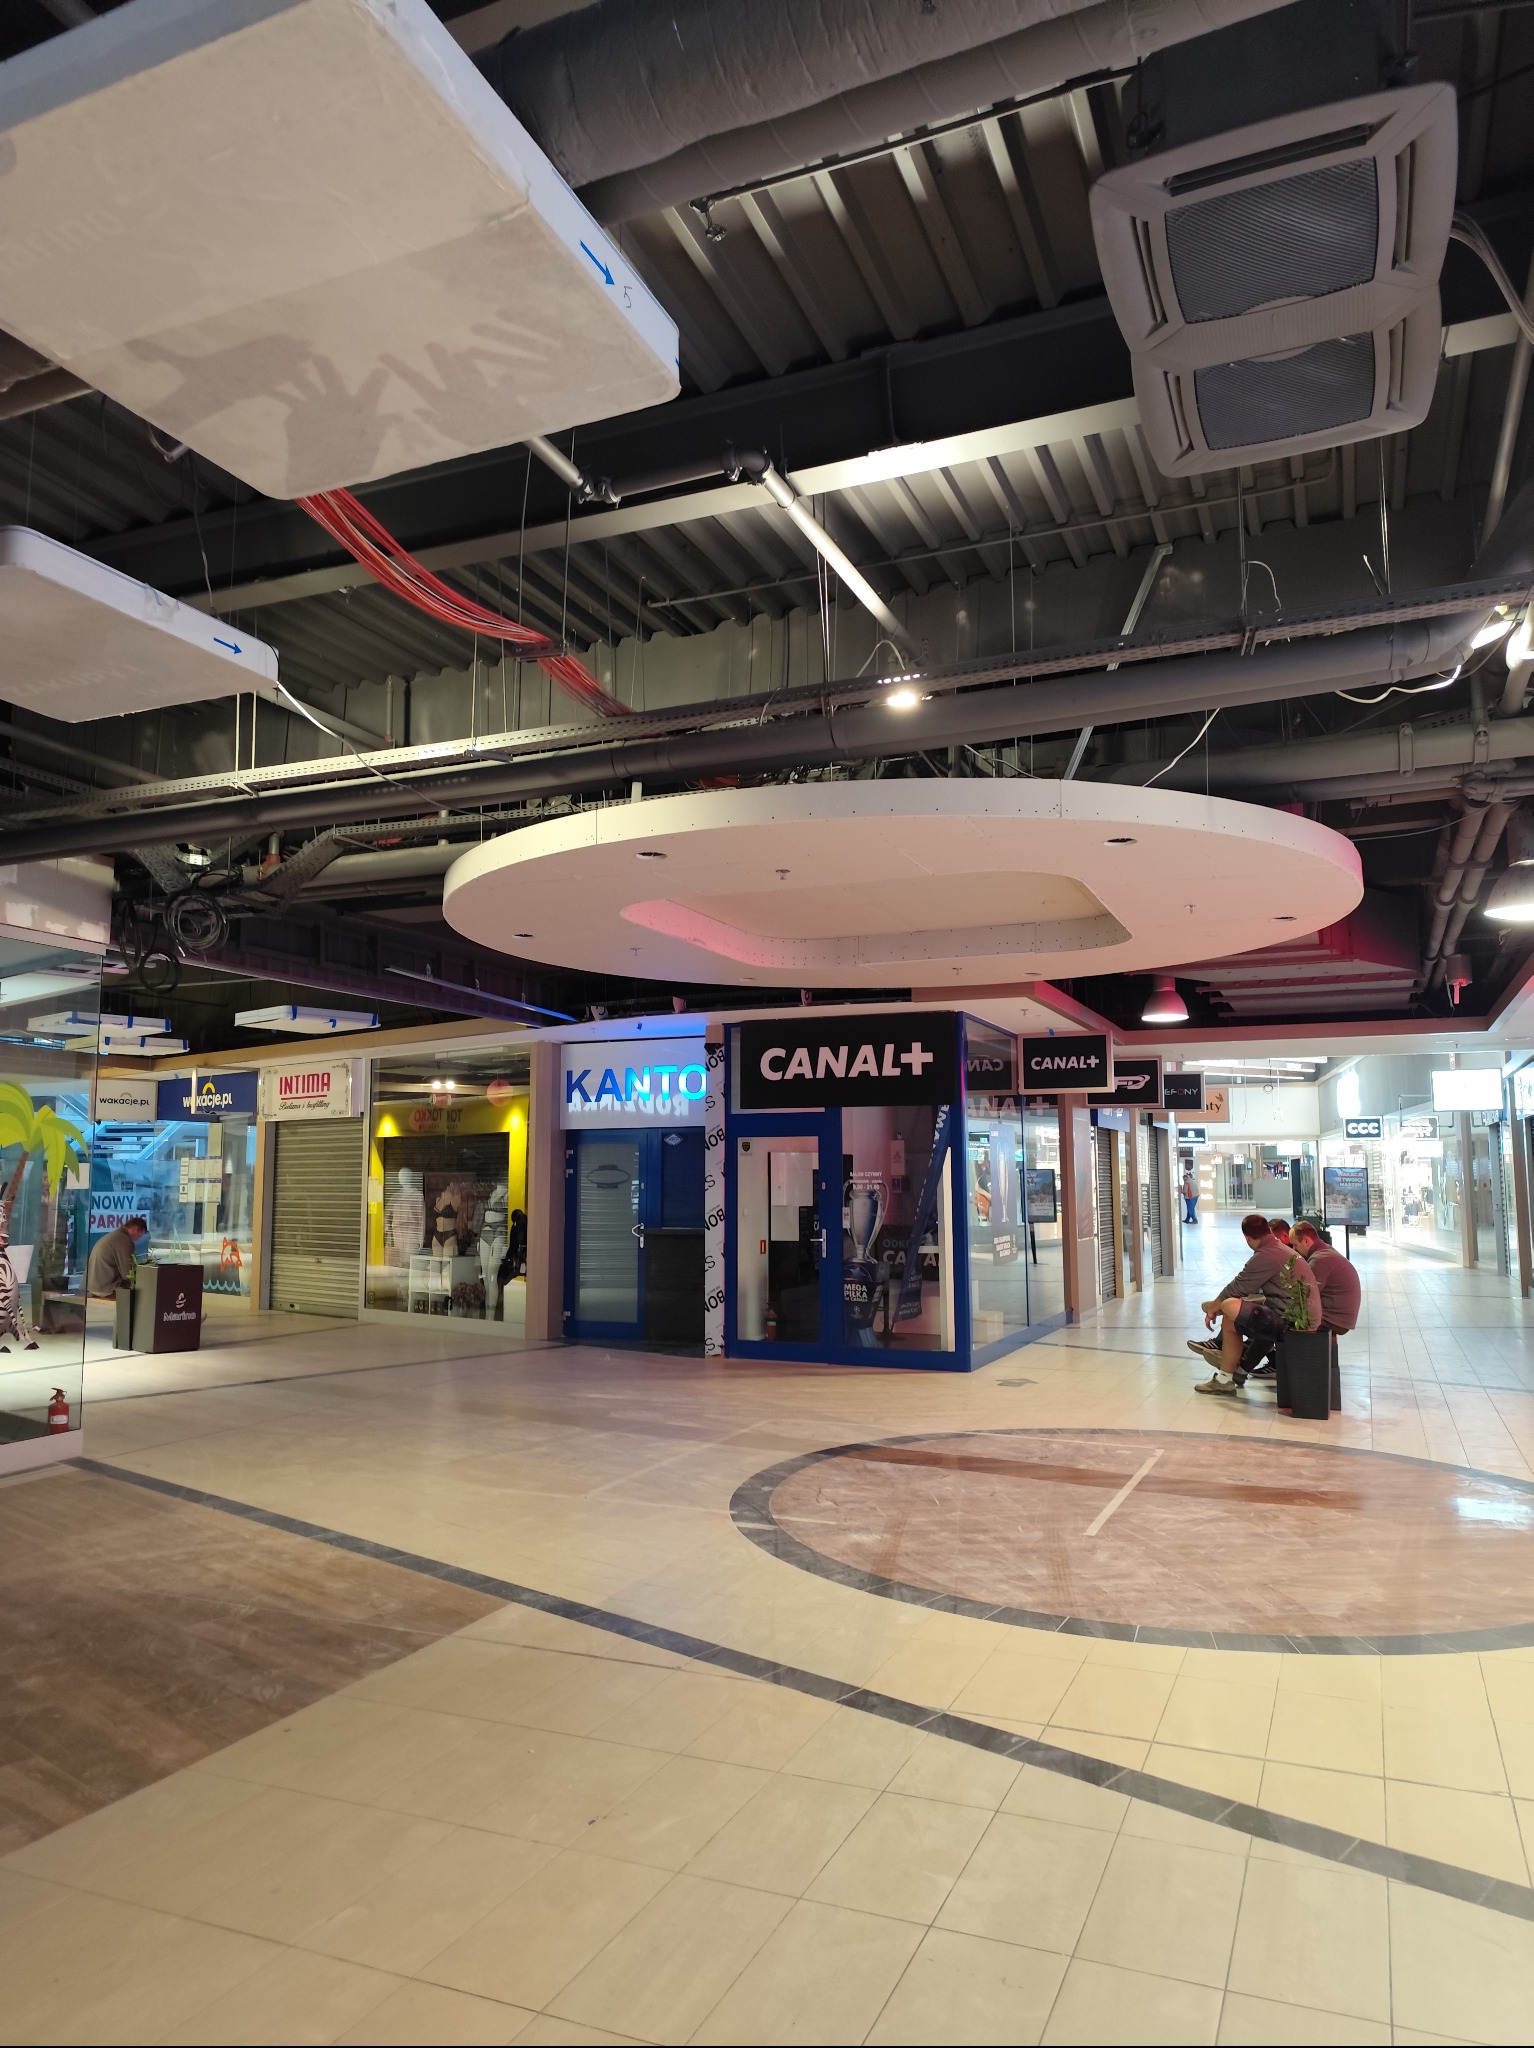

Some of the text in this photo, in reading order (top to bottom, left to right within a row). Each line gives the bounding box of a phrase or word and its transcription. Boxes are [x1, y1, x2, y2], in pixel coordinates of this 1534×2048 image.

[623, 285, 633, 309] 5
[760, 1041, 934, 1081] CANAL+
[1030, 1055, 1100, 1071] CANAL+
[279, 1072, 331, 1096] INTIMA
[99, 1095, 150, 1107] wakacje.pl
[182, 1092, 233, 1109] wkacje.pl
[1347, 1122, 1380, 1135] CCC
[91, 1195, 134, 1210] NOWY
